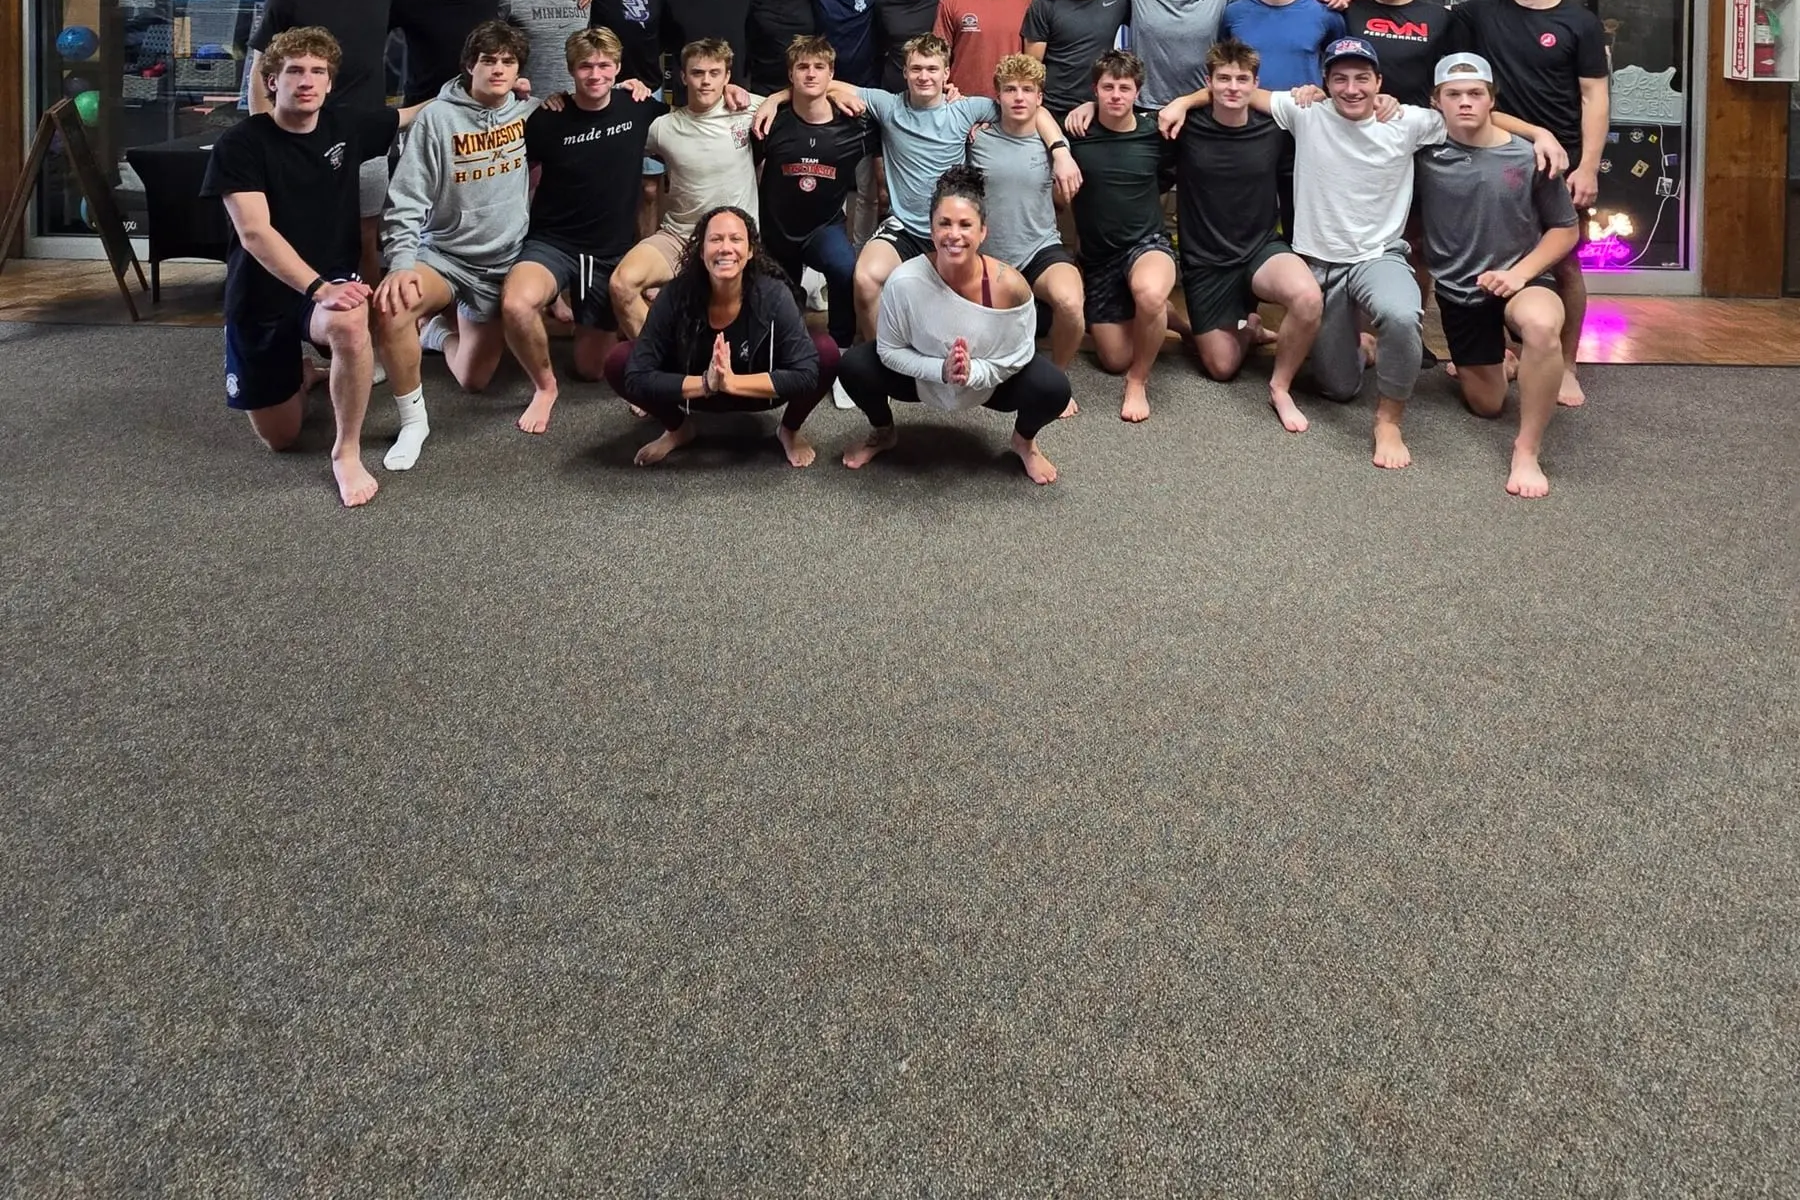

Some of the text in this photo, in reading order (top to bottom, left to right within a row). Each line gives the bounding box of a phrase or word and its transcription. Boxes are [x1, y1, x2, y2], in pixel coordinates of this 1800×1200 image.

[1363, 30, 1428, 42] PERFORMANCE
[1616, 98, 1674, 118] OPEN
[563, 120, 633, 145] made new
[455, 155, 525, 183] HOCKE
